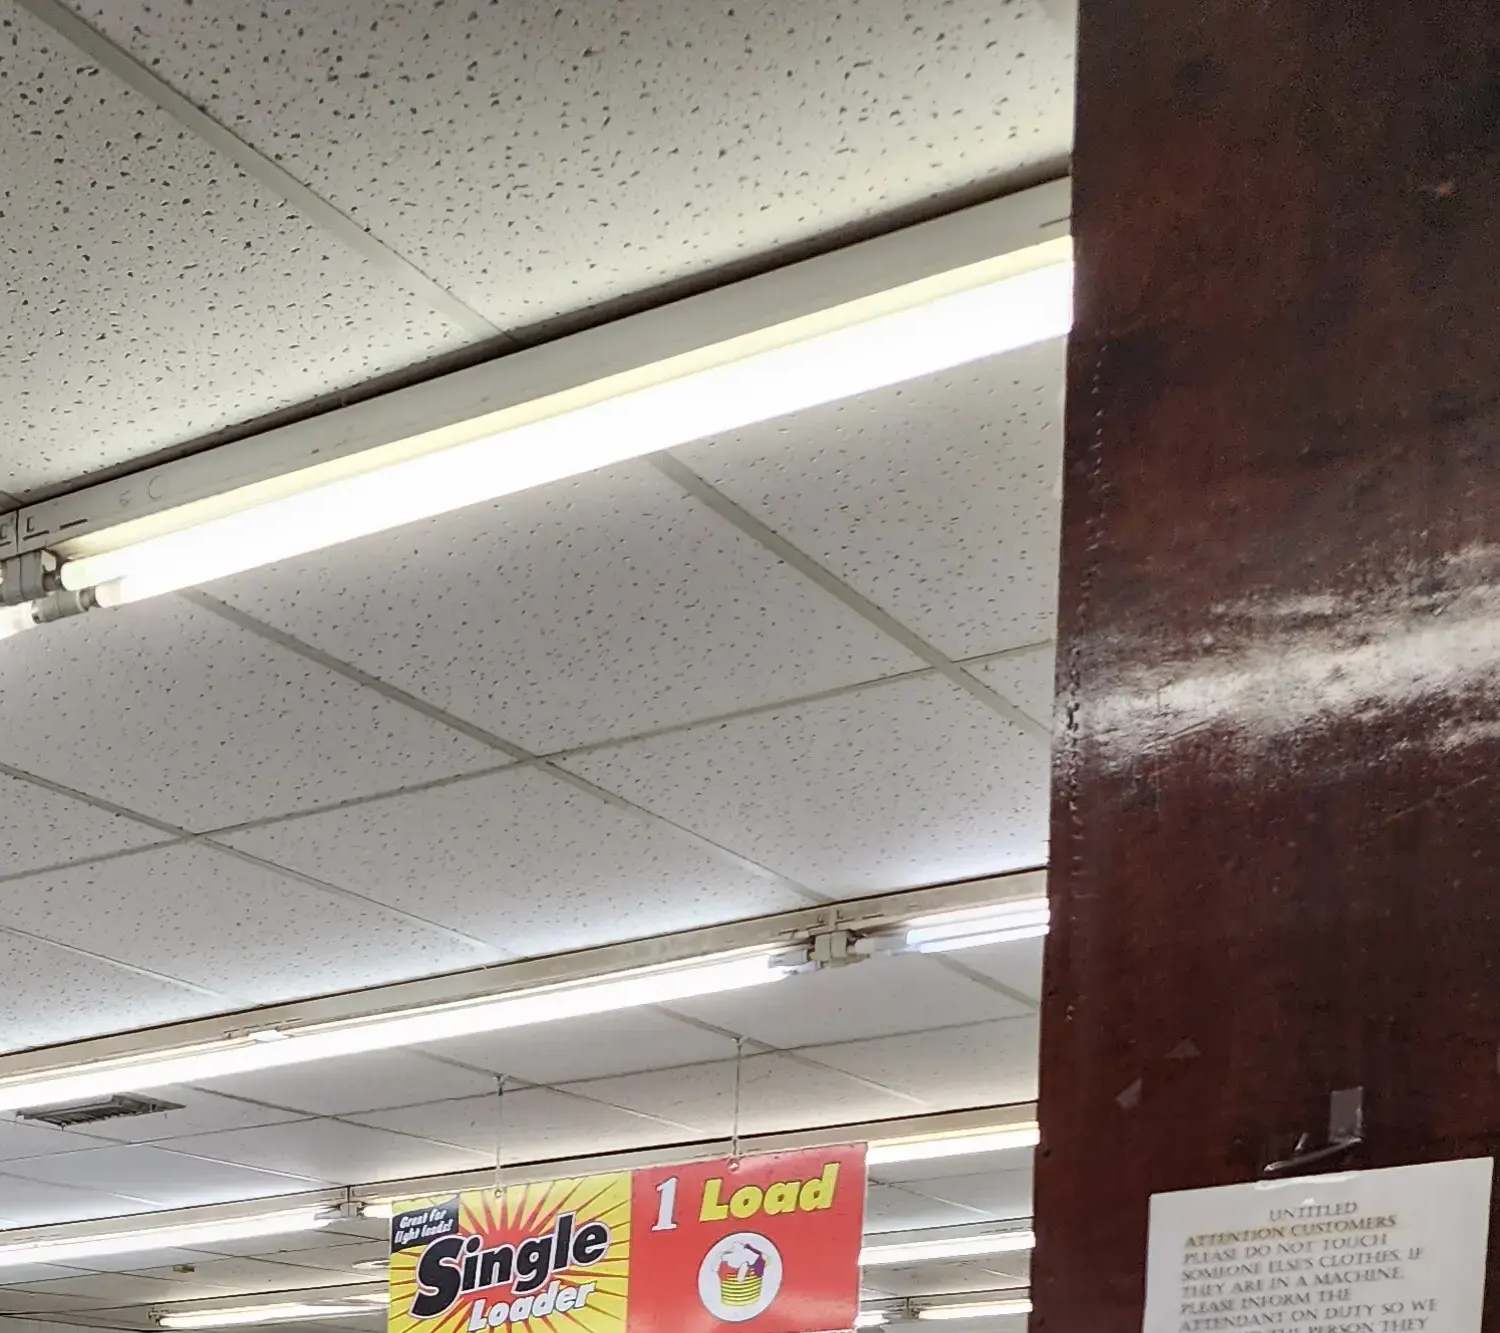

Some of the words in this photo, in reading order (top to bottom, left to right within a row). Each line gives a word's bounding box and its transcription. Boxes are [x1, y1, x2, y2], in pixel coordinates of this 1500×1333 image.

[651, 1177, 679, 1232] 1
[697, 1161, 841, 1222] Load
[1269, 1202, 1357, 1222] UNTITLED
[394, 1227, 420, 1245] light
[421, 1219, 453, 1237] loads!
[399, 1212, 428, 1228] Great
[1185, 1226, 1285, 1248] ATTENTION
[1291, 1215, 1397, 1236] CUSTOMERS
[1182, 1262, 1260, 1281] SOMEONE
[1408, 1247, 1424, 1260] IF
[1183, 1248, 1237, 1264] PLEASE
[1245, 1245, 1271, 1258] DO
[1277, 1241, 1314, 1255] NOT
[1323, 1233, 1387, 1251] TOUCH
[409, 1211, 611, 1321] Single
[1180, 1299, 1235, 1315] PLEASE
[1241, 1291, 1311, 1310] INFORM
[1317, 1288, 1352, 1303] THE
[1181, 1282, 1226, 1298] THEY
[1231, 1279, 1262, 1294] ARE
[1270, 1277, 1289, 1290] IN
[1296, 1276, 1308, 1287] A
[466, 1280, 596, 1333] Loader
[1179, 1311, 1284, 1333] ATTENDANT
[1291, 1308, 1318, 1322] ON
[1324, 1304, 1376, 1320] DUTY
[1381, 1301, 1405, 1316] SO
[1411, 1298, 1438, 1312] WE
[1380, 1316, 1429, 1333] THEY
